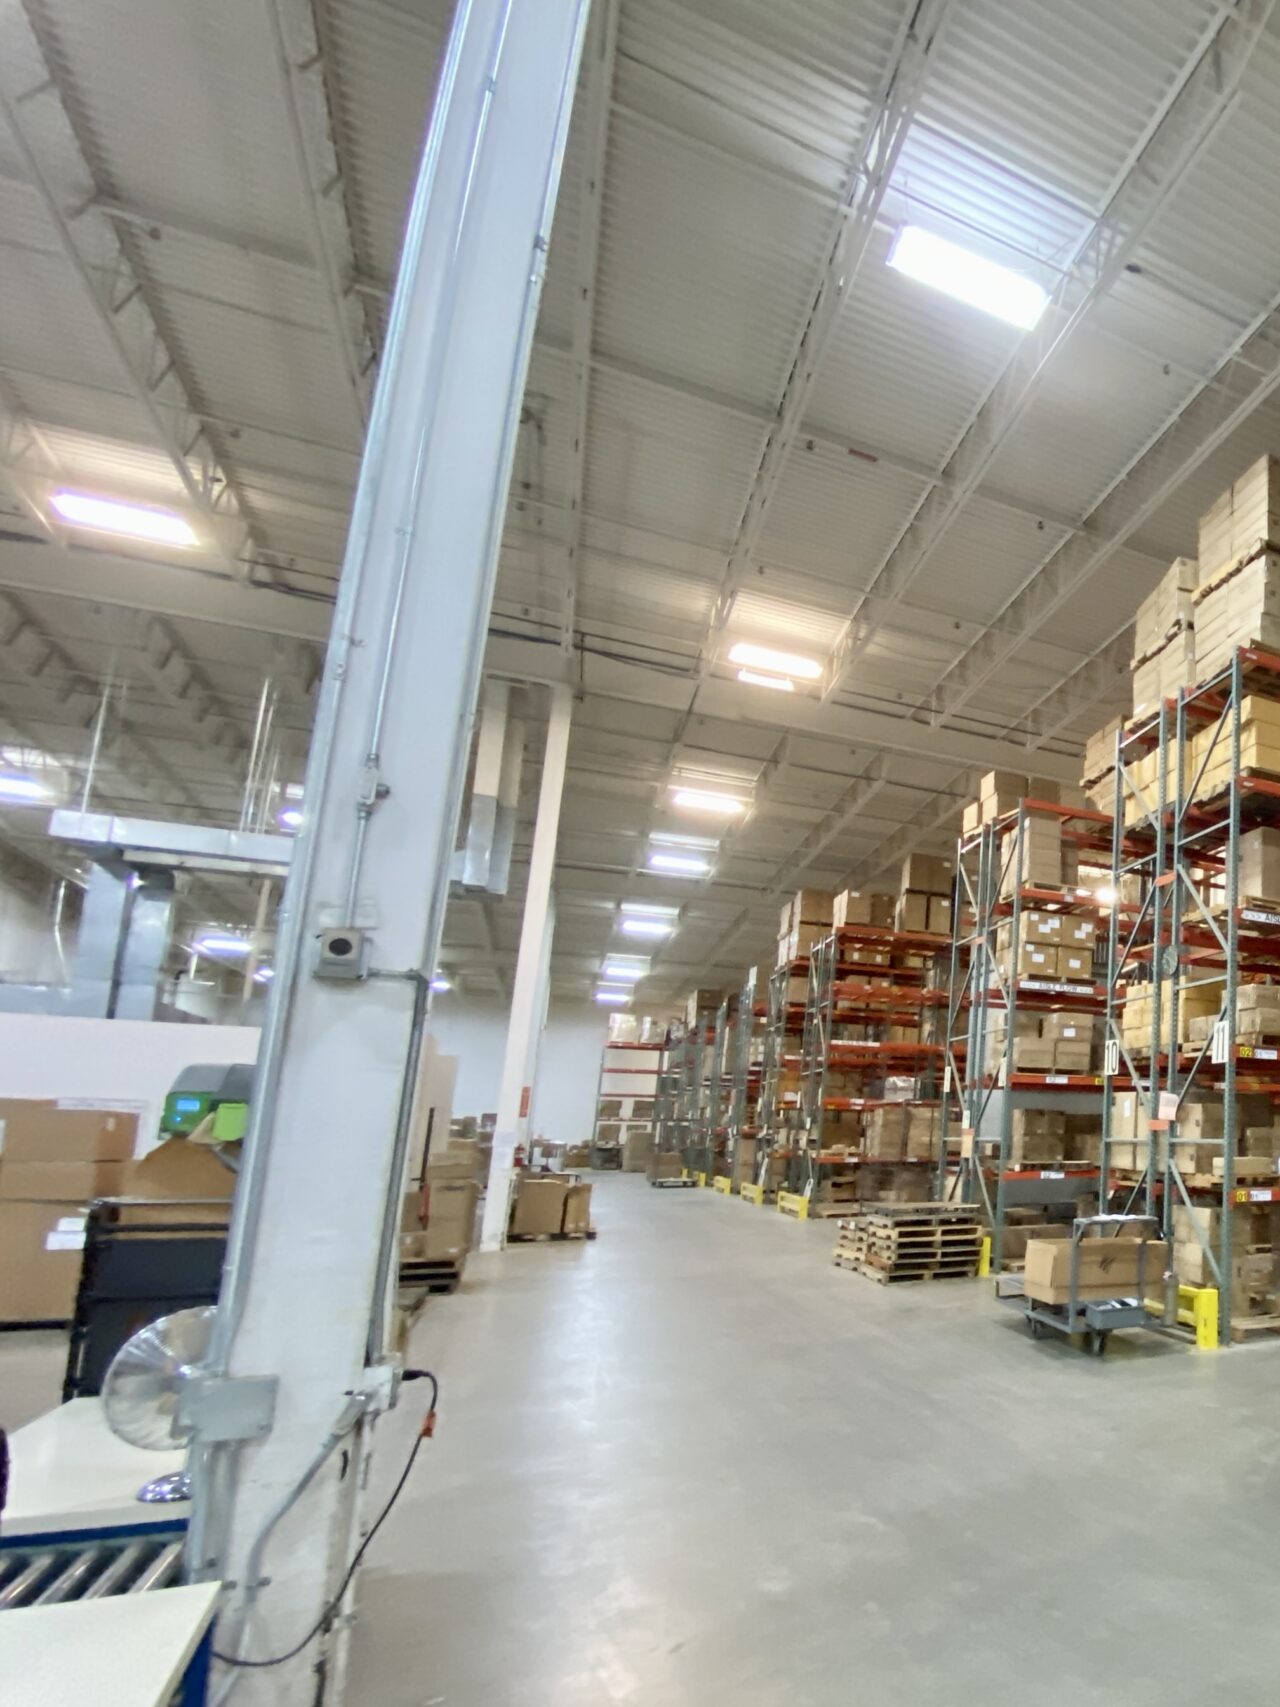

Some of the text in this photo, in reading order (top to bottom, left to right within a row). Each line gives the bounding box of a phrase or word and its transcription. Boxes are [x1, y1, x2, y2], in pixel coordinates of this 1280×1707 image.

[1216, 1024, 1225, 1062] 11
[1240, 1047, 1251, 1057] 02
[1105, 1041, 1118, 1073] 10
[1237, 1191, 1248, 1201] 01
